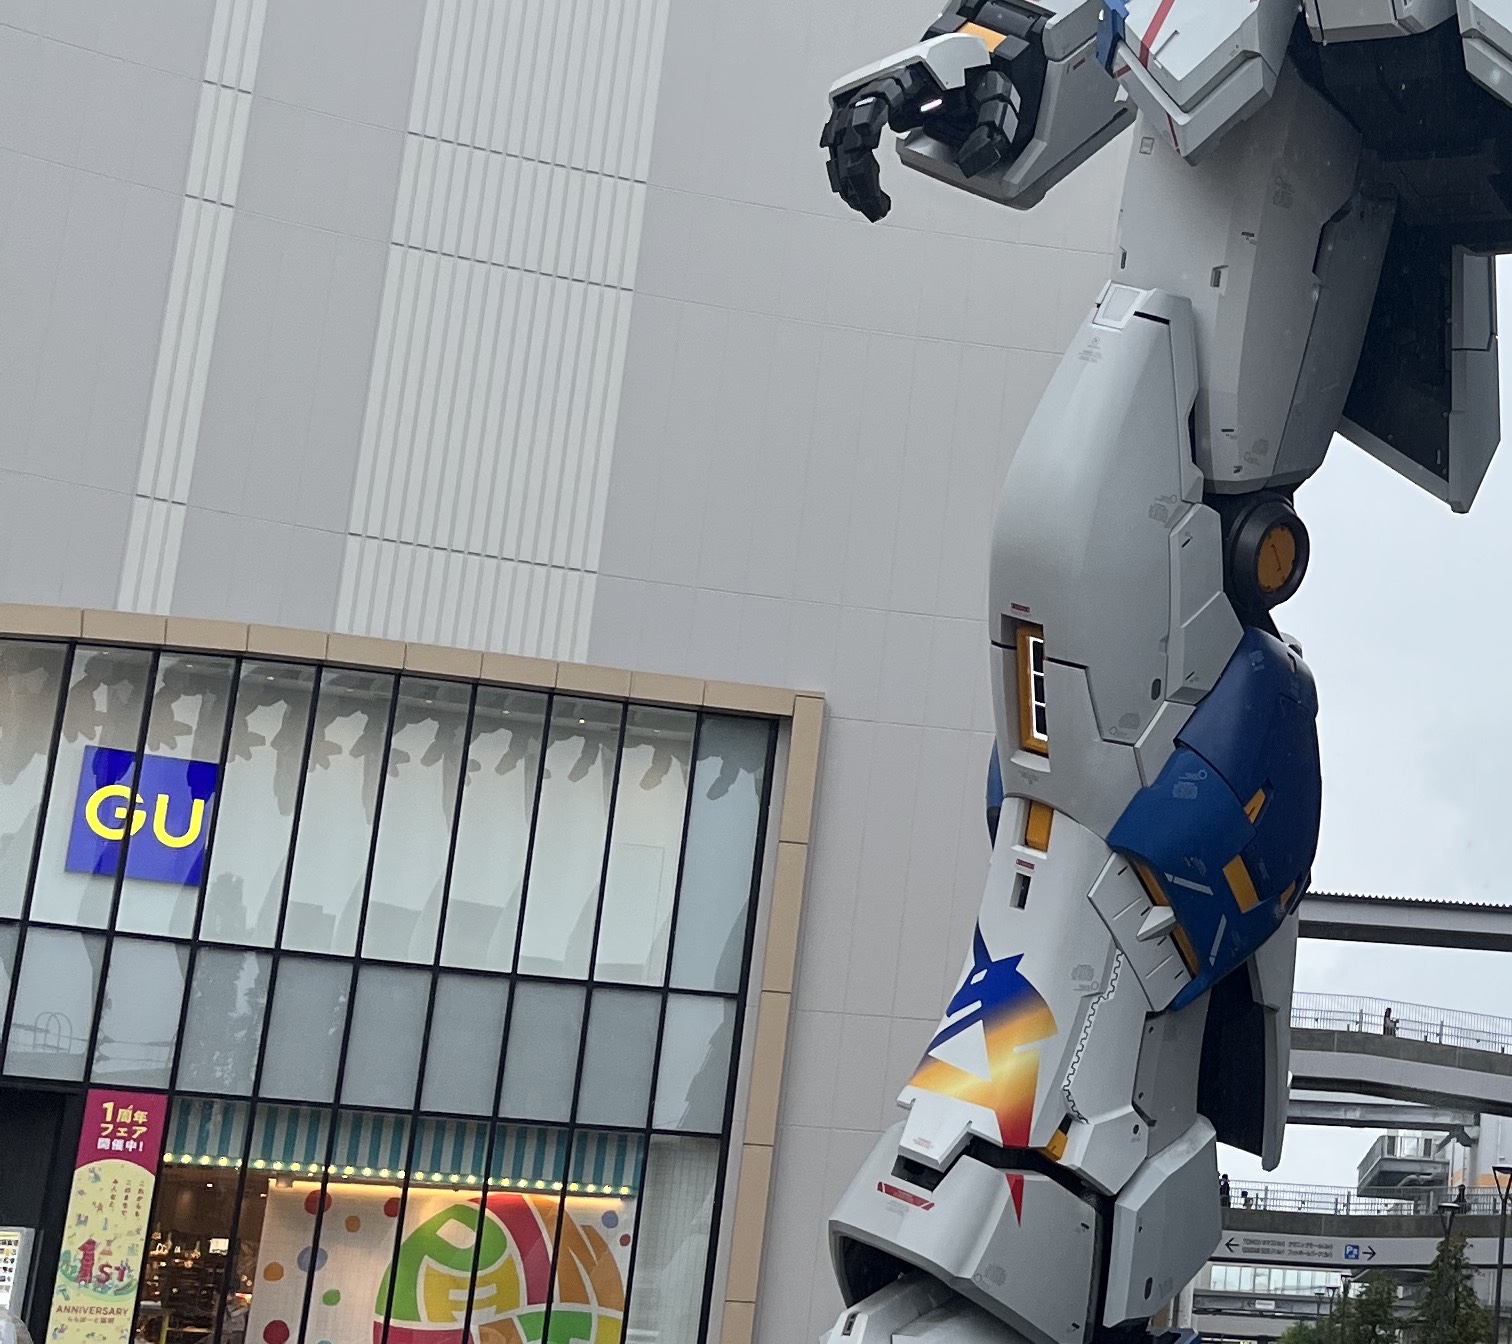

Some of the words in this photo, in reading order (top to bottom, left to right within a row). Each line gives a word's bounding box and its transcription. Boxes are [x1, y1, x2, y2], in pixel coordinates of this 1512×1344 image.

[85, 784, 205, 849] GU
[102, 1101, 149, 1124] 1周年
[99, 1123, 148, 1139] フェア
[55, 1305, 129, 1317] ANNIVERSARY
